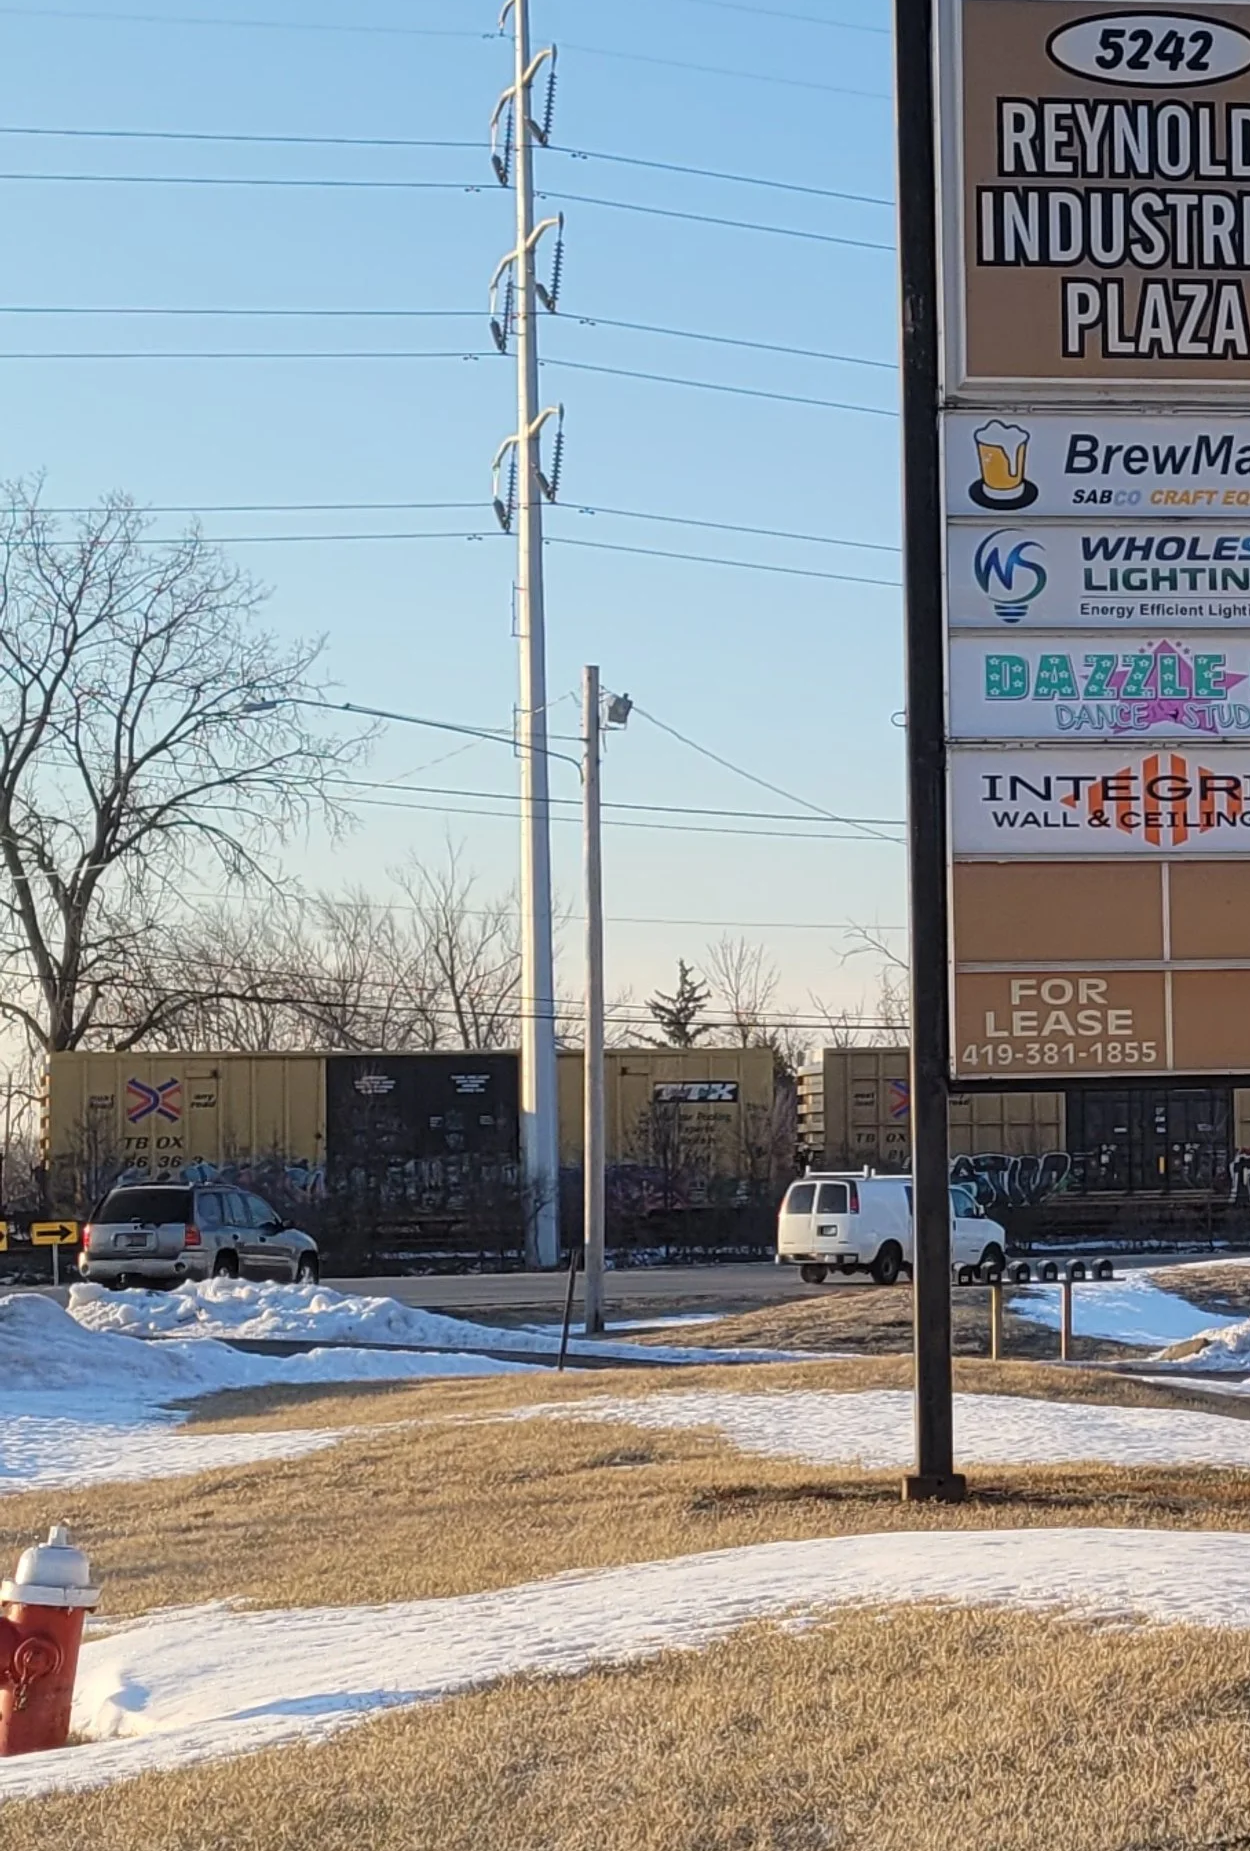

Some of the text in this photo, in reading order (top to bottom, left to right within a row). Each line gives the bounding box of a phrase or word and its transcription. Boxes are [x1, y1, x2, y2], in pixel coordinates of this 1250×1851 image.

[1095, 29, 1213, 71] 5242
[1072, 489, 1141, 505] SABCO
[1150, 489, 1219, 506] CRAFT
[1080, 603, 1135, 619] Energy
[1140, 603, 1203, 617] Efficient
[984, 653, 1228, 701] DAZZLE
[1055, 704, 1150, 731] DANCE
[992, 810, 1080, 828] WALL
[1088, 809, 1112, 828] &
[1010, 978, 1109, 1006] FOR
[985, 1009, 1133, 1038] LEASE
[962, 1041, 1157, 1066] 419-381-1855
